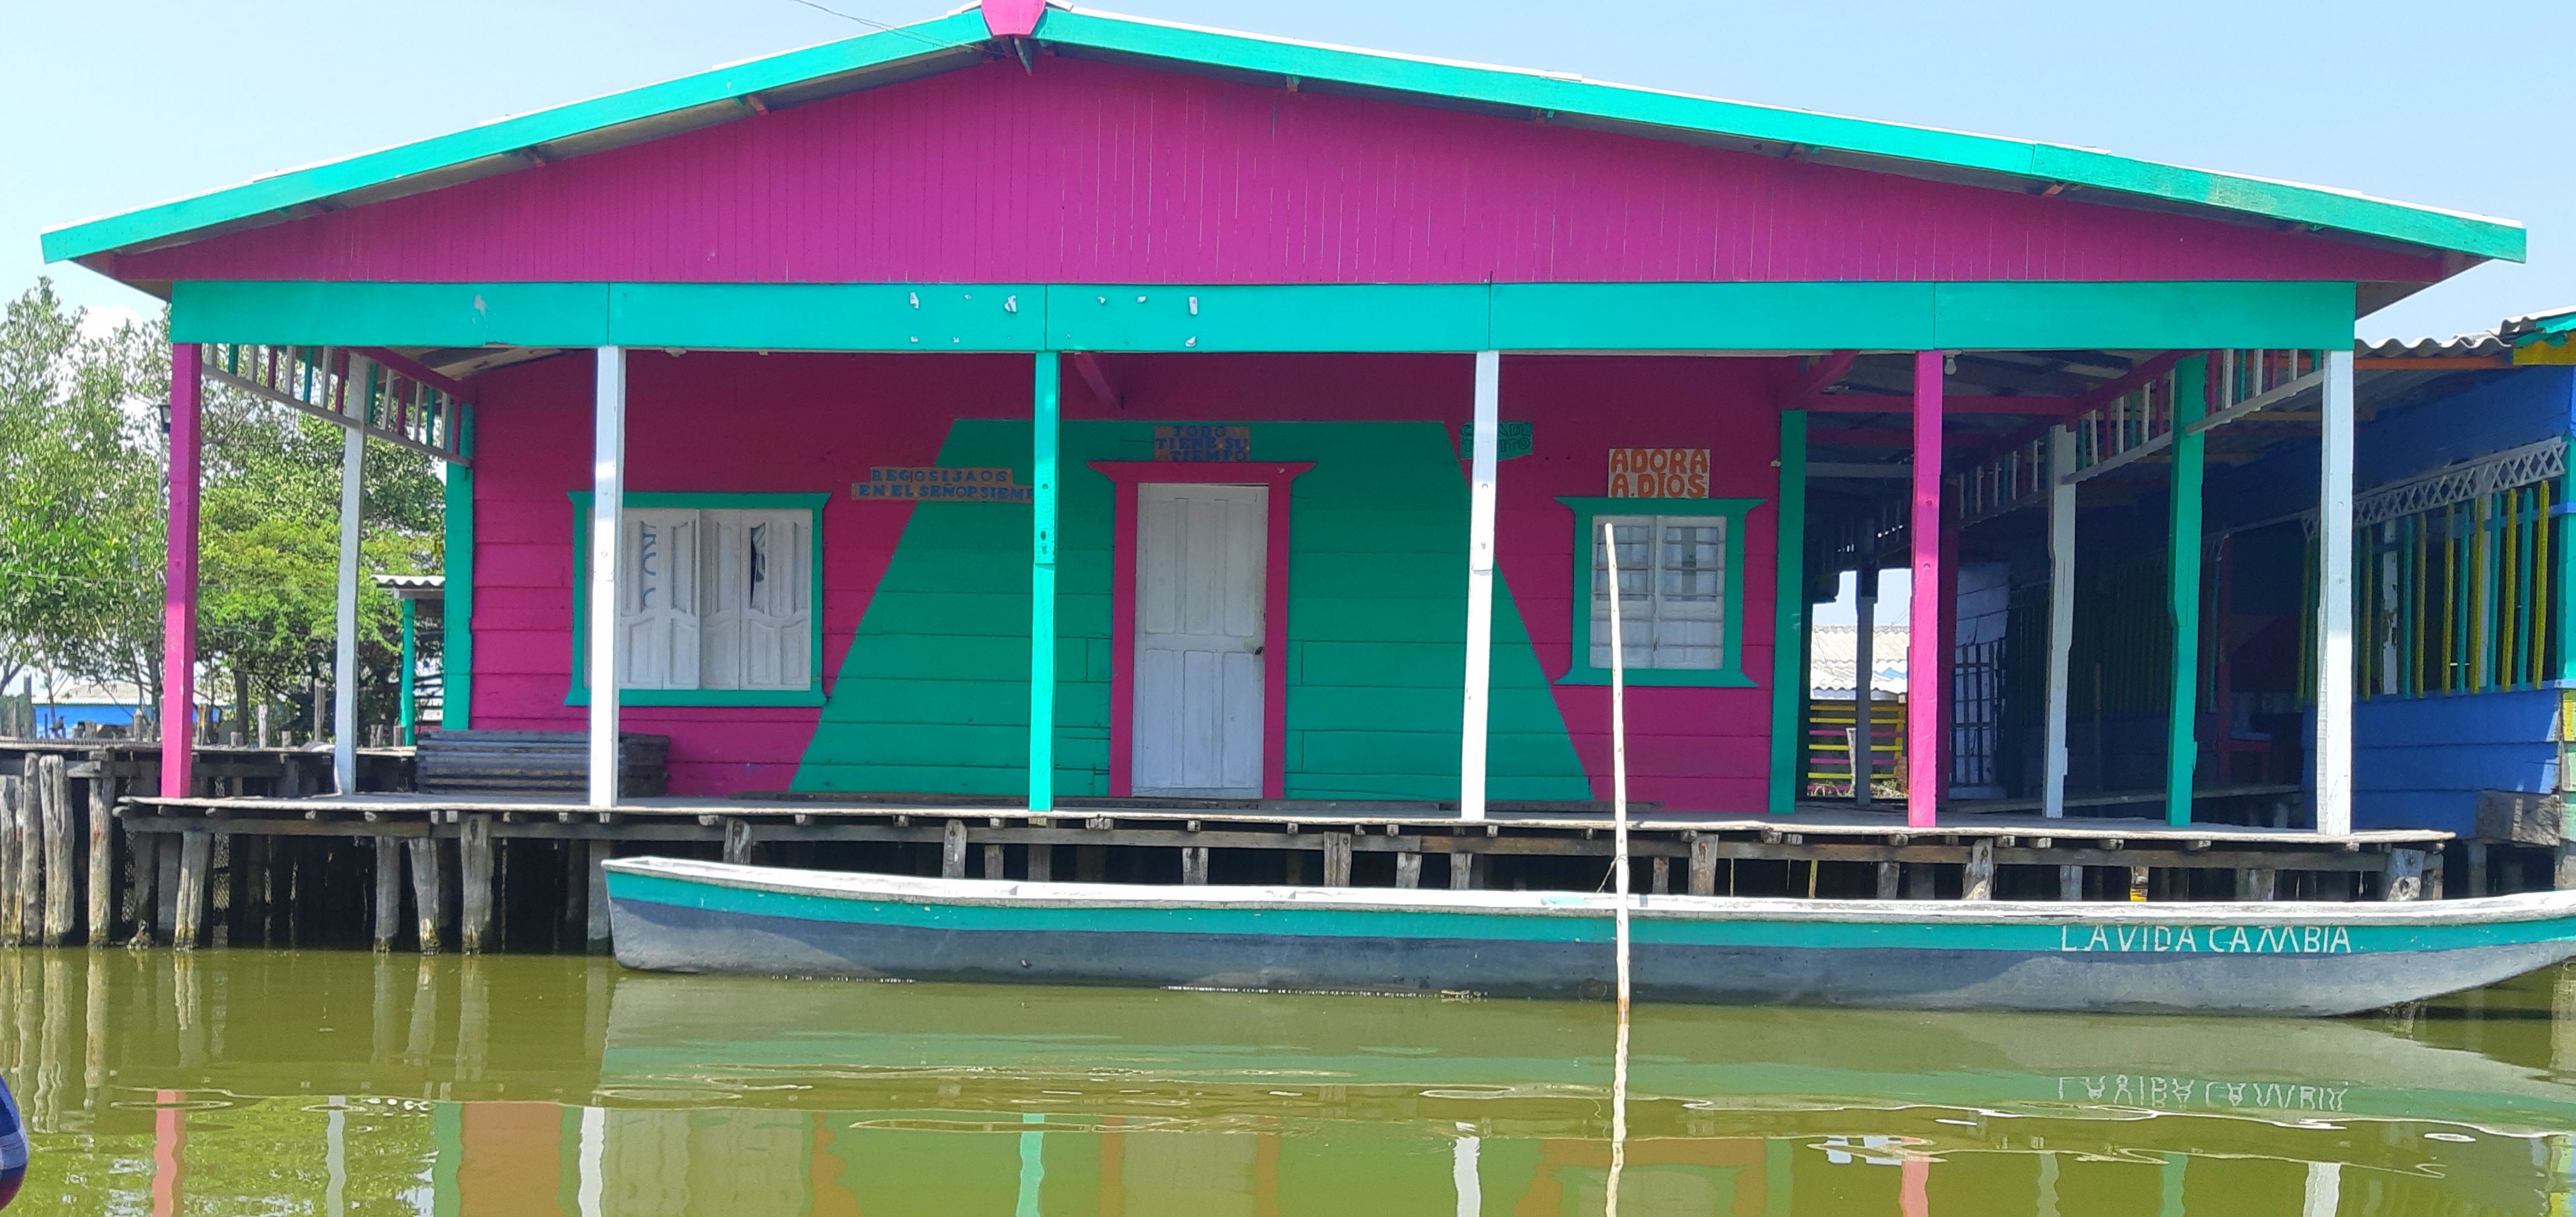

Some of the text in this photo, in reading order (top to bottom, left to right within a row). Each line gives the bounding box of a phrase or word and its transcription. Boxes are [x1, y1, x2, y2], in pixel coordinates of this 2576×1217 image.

[1155, 437, 1216, 450] TIENE
[1170, 450, 1247, 461] TIEMPO
[1610, 448, 1708, 474] ADORA
[859, 484, 885, 496] EN
[891, 484, 914, 496] EL
[1637, 473, 1705, 498] DIOS
[2061, 925, 2352, 954] LA VIDA CAMBIA
